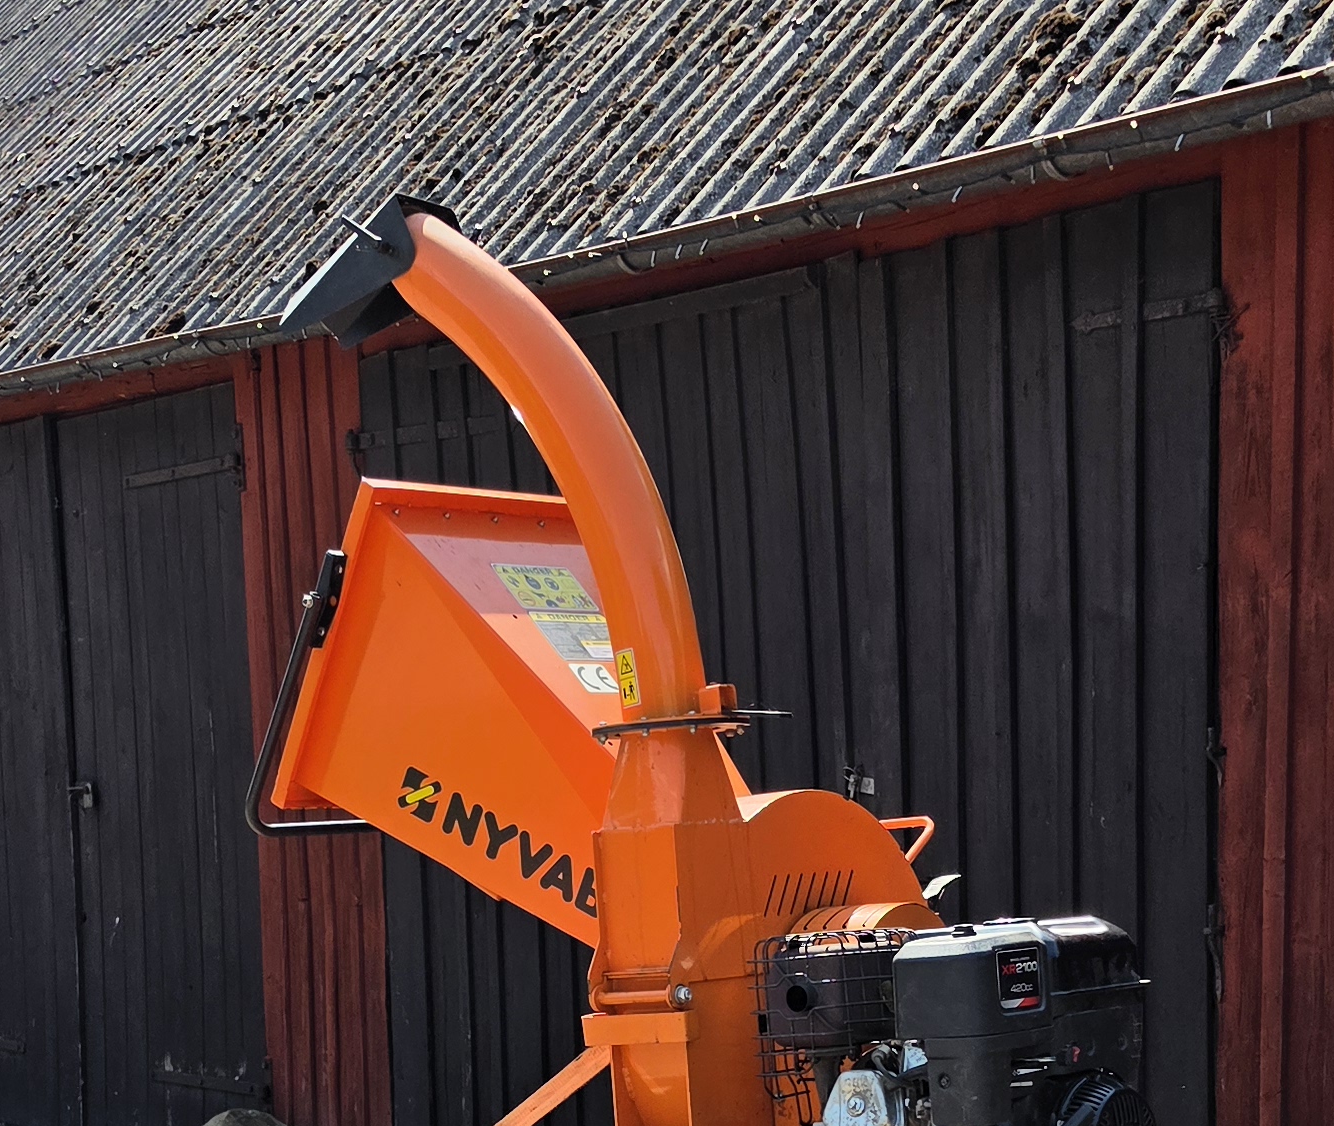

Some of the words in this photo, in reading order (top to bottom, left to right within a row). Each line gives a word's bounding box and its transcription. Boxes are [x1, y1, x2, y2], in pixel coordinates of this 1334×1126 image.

[511, 566, 555, 575] DANGER
[547, 613, 590, 622] DANGER
[577, 666, 619, 691] CE
[1002, 961, 1038, 975] XR2100
[1010, 982, 1034, 993] 420cc
